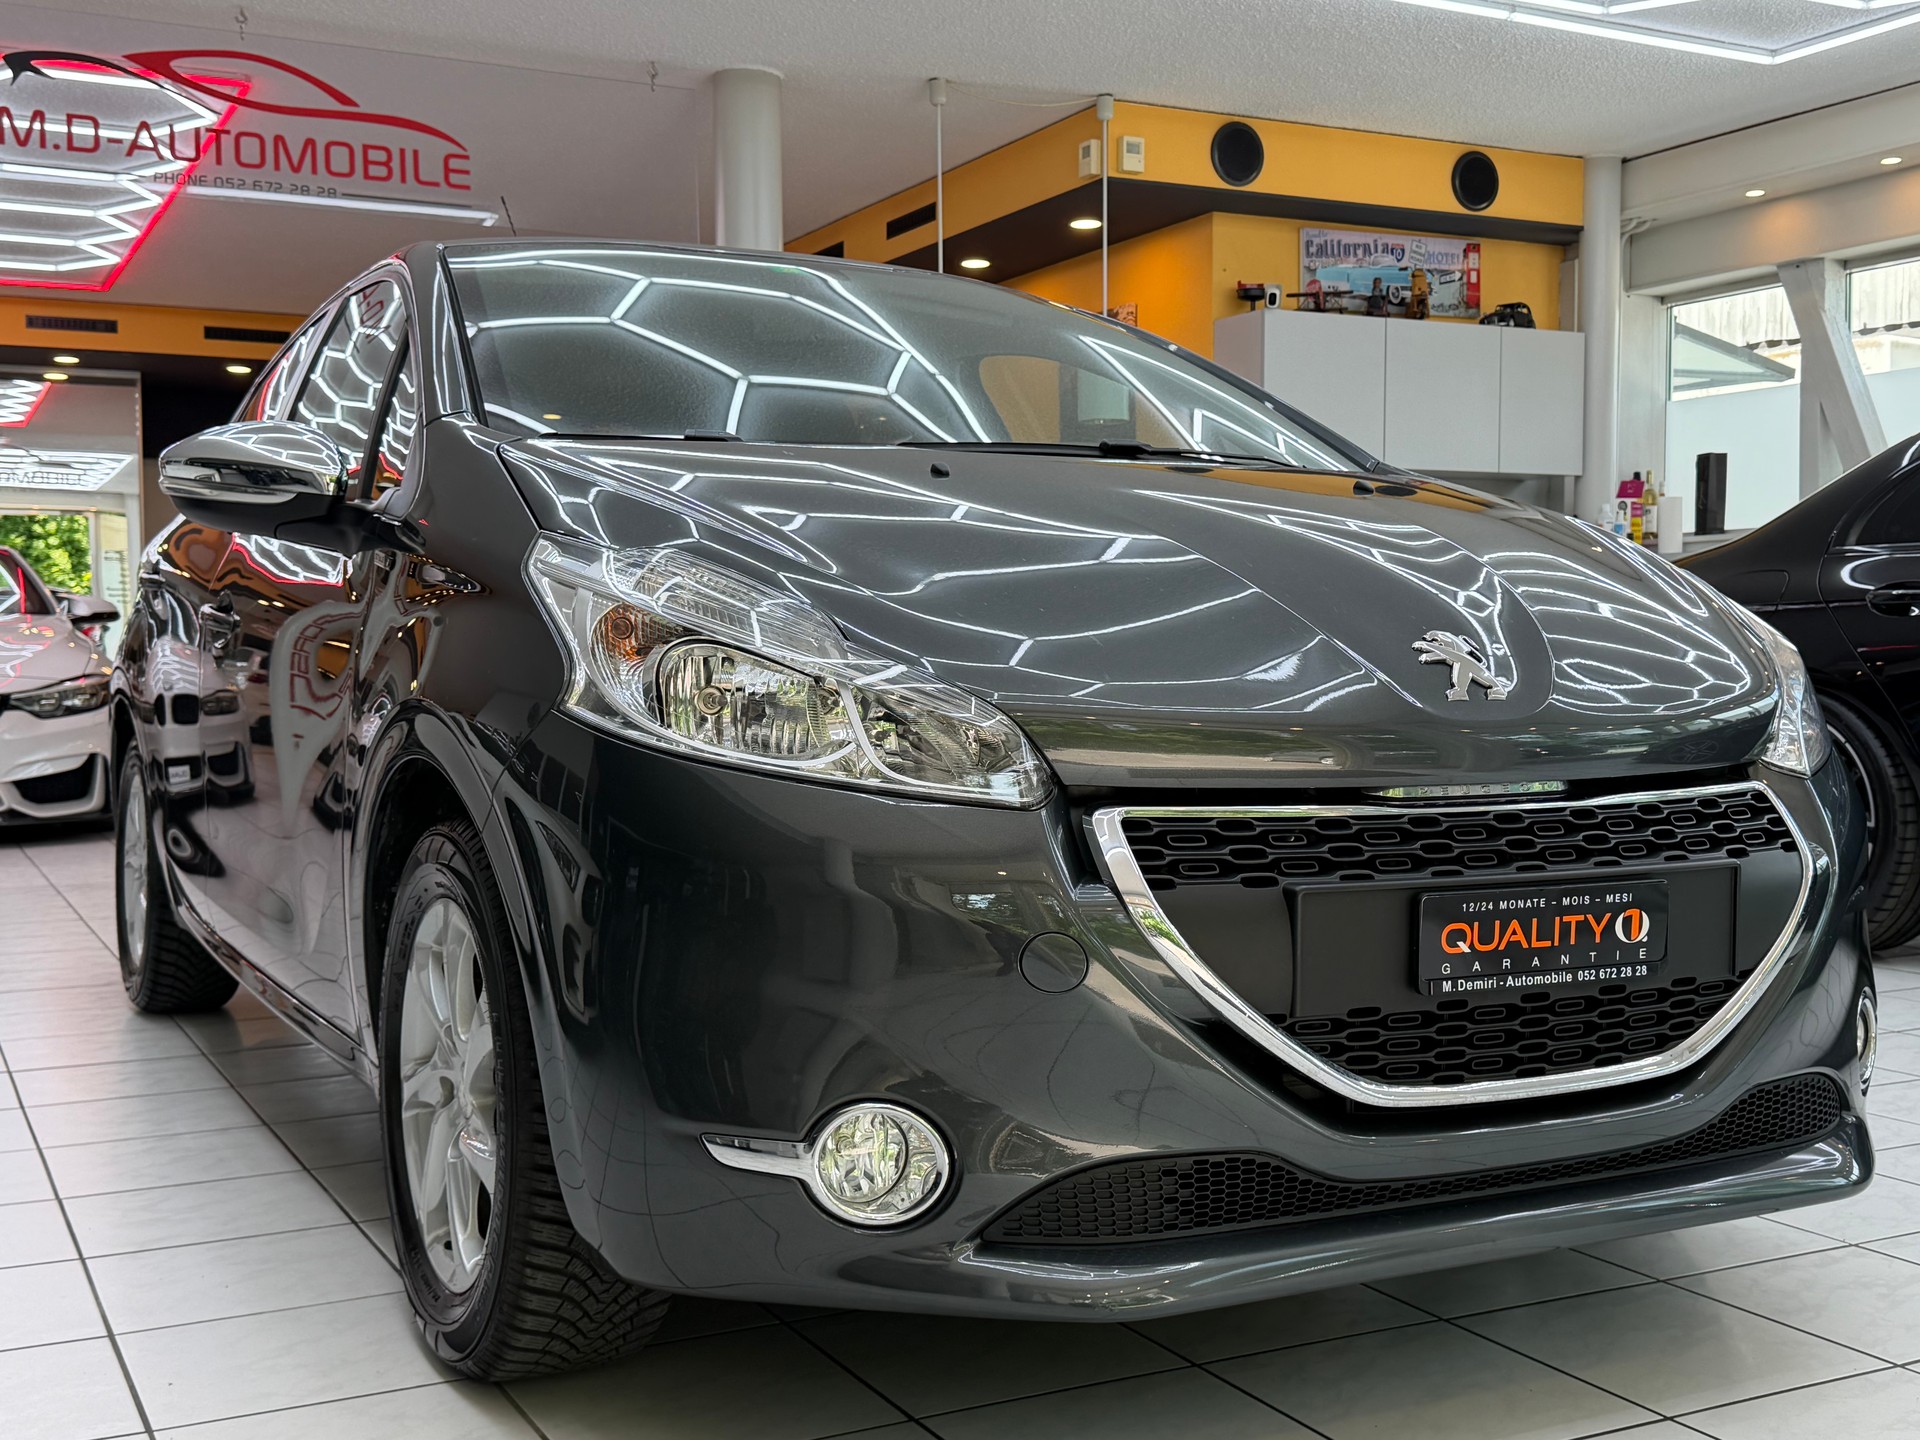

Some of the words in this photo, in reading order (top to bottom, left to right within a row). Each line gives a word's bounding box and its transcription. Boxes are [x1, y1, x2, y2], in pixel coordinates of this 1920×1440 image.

[0, 106, 471, 191] M.D-AUTOMOBILE
[154, 172, 208, 186] PHONE
[213, 176, 246, 190] 052
[252, 180, 283, 193] 672
[289, 183, 310, 197] 28
[316, 186, 337, 199] 28
[1462, 902, 1494, 913] 12/24
[1499, 898, 1546, 910] MONATE
[1562, 896, 1590, 906] MOIS
[1606, 893, 1633, 903] MESI
[1441, 912, 1612, 954] QUALITY
[1441, 948, 1647, 975] GARANTIE
[1577, 969, 1596, 981] 052
[1599, 967, 1617, 979] 672
[1620, 966, 1632, 977] 28
[1635, 965, 1648, 976] 28
